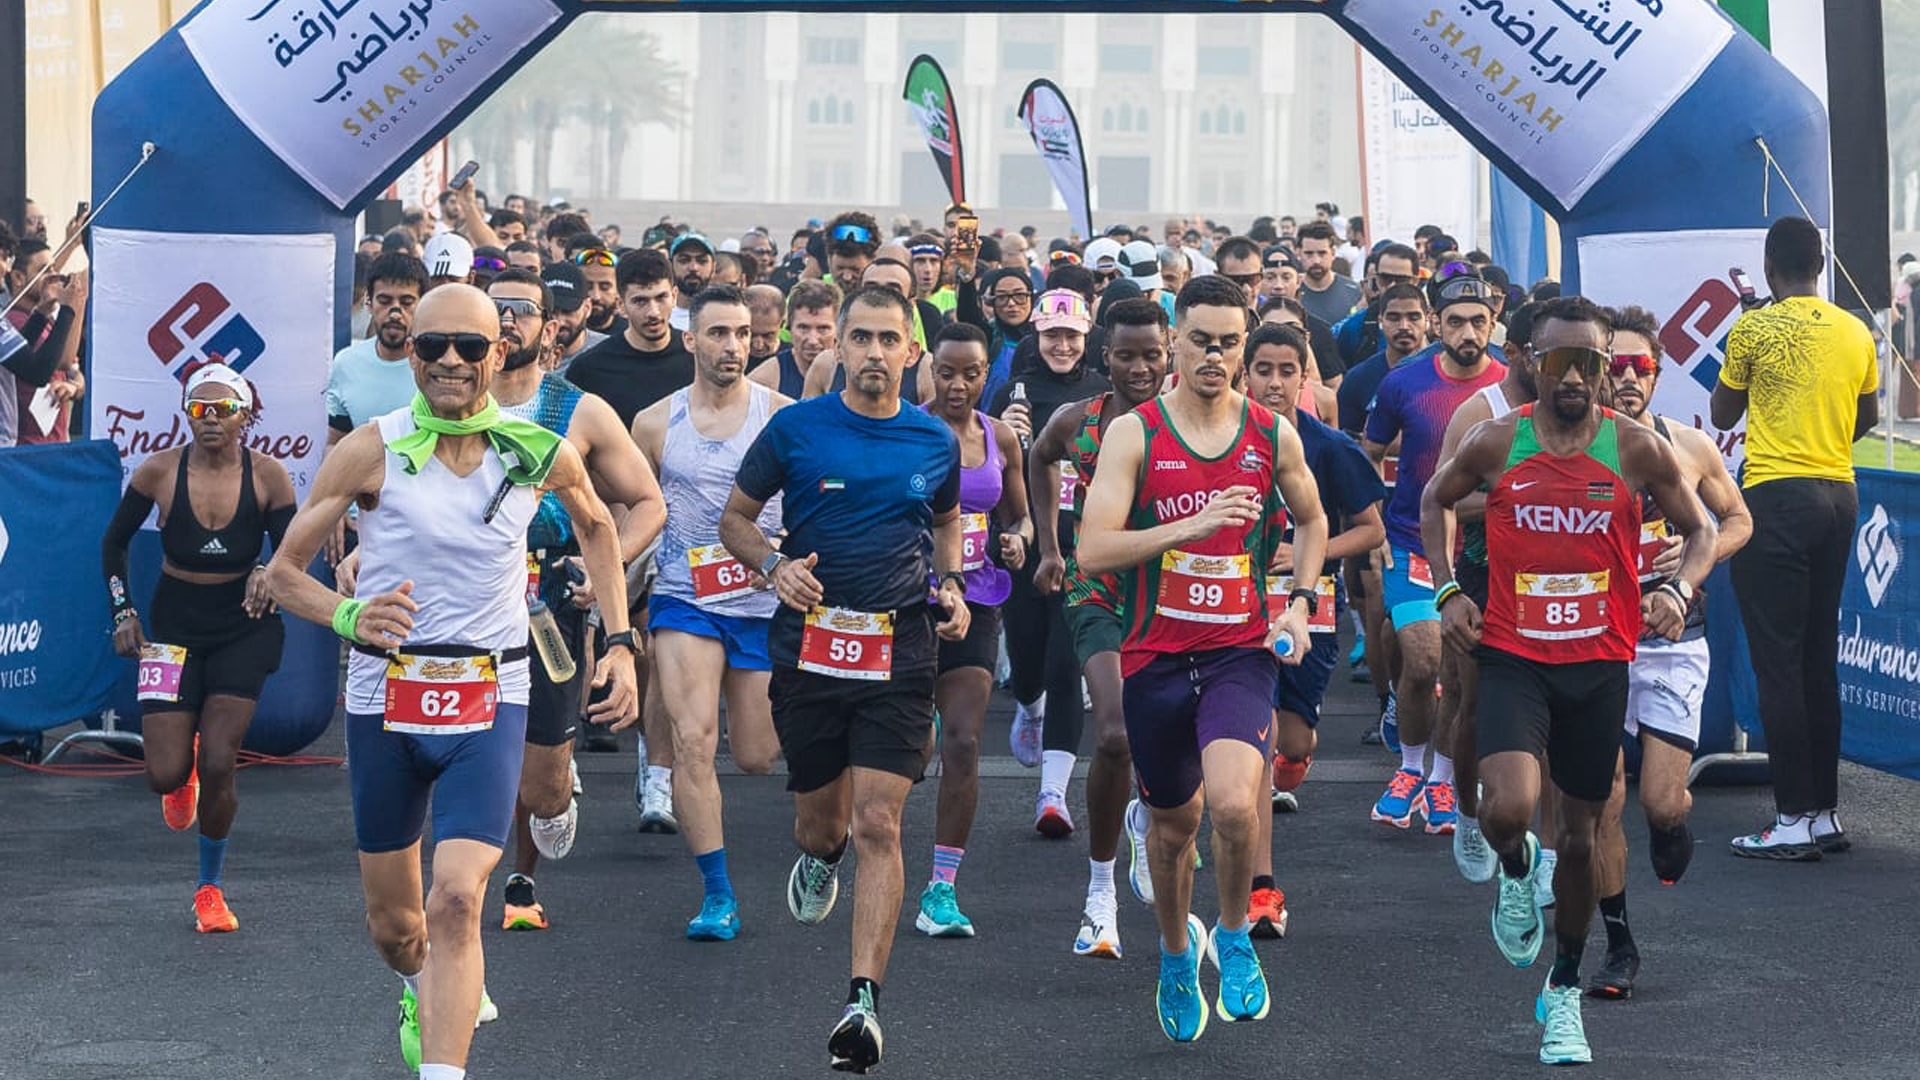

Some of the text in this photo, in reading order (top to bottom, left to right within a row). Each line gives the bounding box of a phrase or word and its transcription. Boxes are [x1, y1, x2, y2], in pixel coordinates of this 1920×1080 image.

[342, 13, 480, 137] SHARJAH
[1423, 8, 1566, 134] SHARJAH
[361, 33, 493, 149] SPORTS COUNCIL
[1411, 28, 1545, 146] SPORTS COUNCIL
[106, 405, 314, 459] Endnce
[1514, 504, 1612, 534] KENYA
[717, 563, 746, 586] 63
[1188, 582, 1224, 607] 99
[1545, 602, 1581, 625] 85
[829, 637, 863, 663] 59
[0, 666, 37, 688] VICES
[421, 689, 460, 717] 62
[1865, 689, 1920, 721] SERVICE
